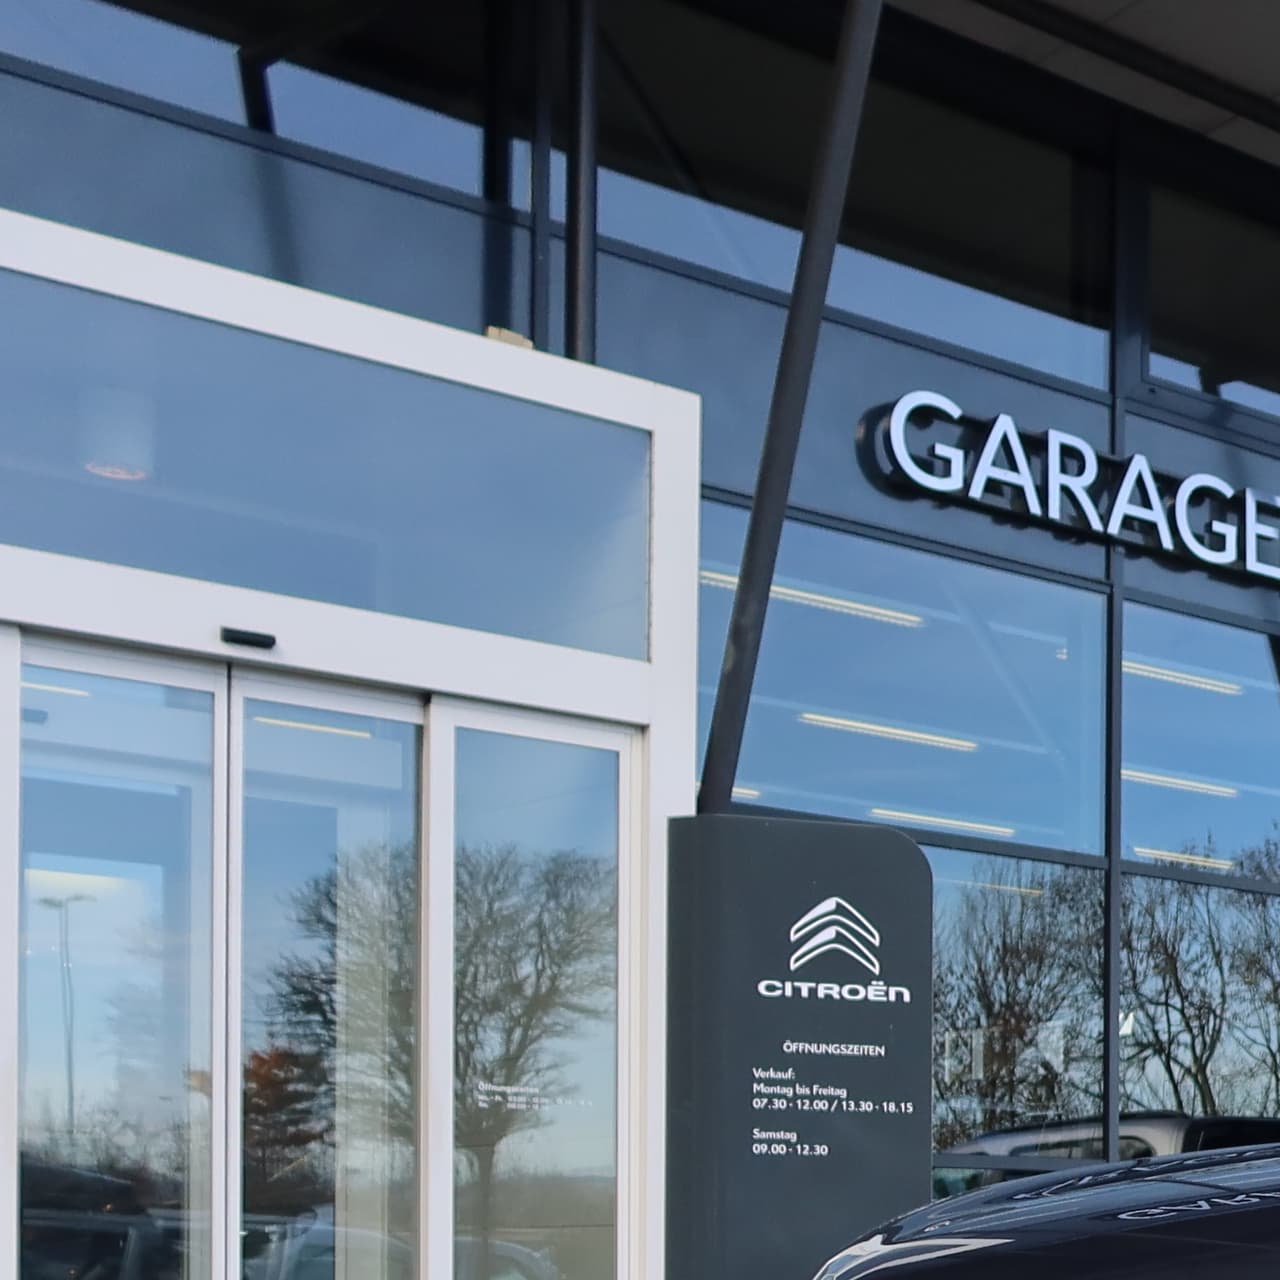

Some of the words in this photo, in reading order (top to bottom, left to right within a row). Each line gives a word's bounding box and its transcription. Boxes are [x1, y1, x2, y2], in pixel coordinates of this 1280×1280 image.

[783, 1040, 886, 1057] ÖFFNUNGSZEITEN
[752, 1067, 796, 1080] Verkauf:
[753, 1083, 793, 1097] Montag
[795, 1083, 811, 1095] bis
[812, 1084, 848, 1098] Freitag
[752, 1098, 788, 1110] 07.30
[796, 1099, 829, 1111] 12.00
[830, 1099, 839, 1112] /
[842, 1100, 874, 1112] 13.30
[882, 1102, 914, 1113] 18.15
[752, 1128, 798, 1143] Samstag
[752, 1143, 787, 1155] 09.00
[796, 1144, 829, 1156] 12.30
